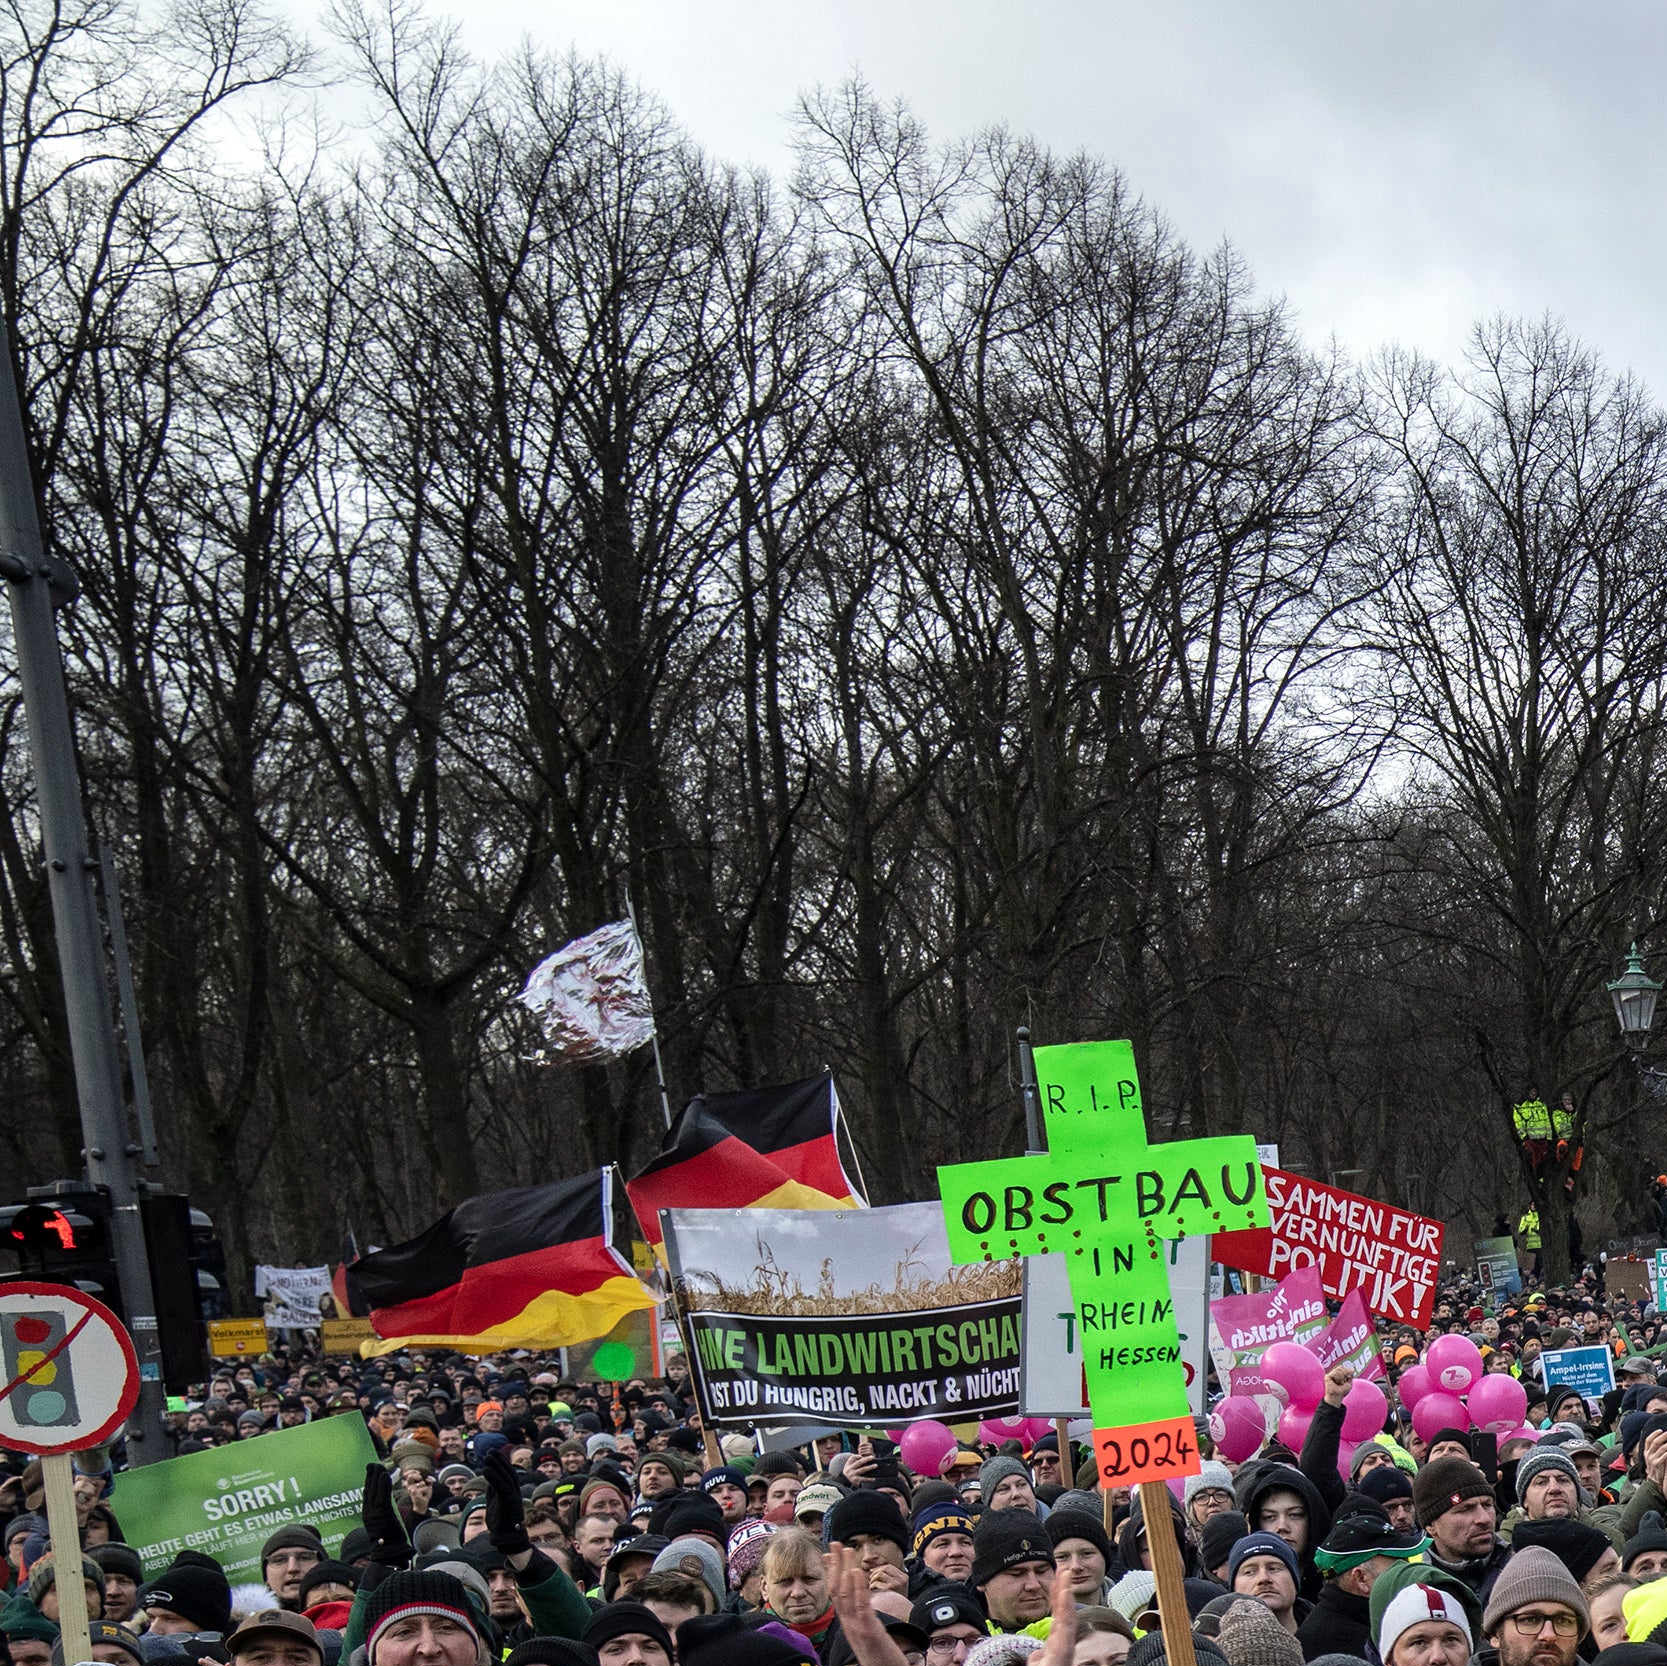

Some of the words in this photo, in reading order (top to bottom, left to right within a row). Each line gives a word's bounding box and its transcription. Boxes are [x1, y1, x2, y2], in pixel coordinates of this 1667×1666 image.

[1261, 1175, 1385, 1238] SAMMEN
[1388, 1213, 1441, 1256] FÜR
[1093, 1244, 1134, 1277] IN
[1269, 1209, 1439, 1288] VERNÜNFTIGE
[1081, 1298, 1174, 1333] RHEIN-
[1099, 1346, 1181, 1370] HESSEN
[733, 1379, 758, 1407] DU
[764, 1385, 867, 1416] HUNGRIG,
[869, 1379, 939, 1410] NACKT
[945, 1376, 962, 1404] &
[966, 1368, 1021, 1398] NÜCHT
[1102, 1428, 1195, 1478] 2024
[202, 1484, 287, 1522] SORRY
[704, 1474, 727, 1491] RUW
[138, 1538, 184, 1560] HEUTE
[184, 1527, 221, 1548] GEHT
[223, 1521, 243, 1537] ES
[244, 1508, 294, 1532] ETWAS
[144, 1557, 167, 1572] ABER
[205, 1538, 234, 1555] LÄUFT
[235, 1533, 259, 1549] HIER
[319, 1506, 355, 1525] NICHTS
